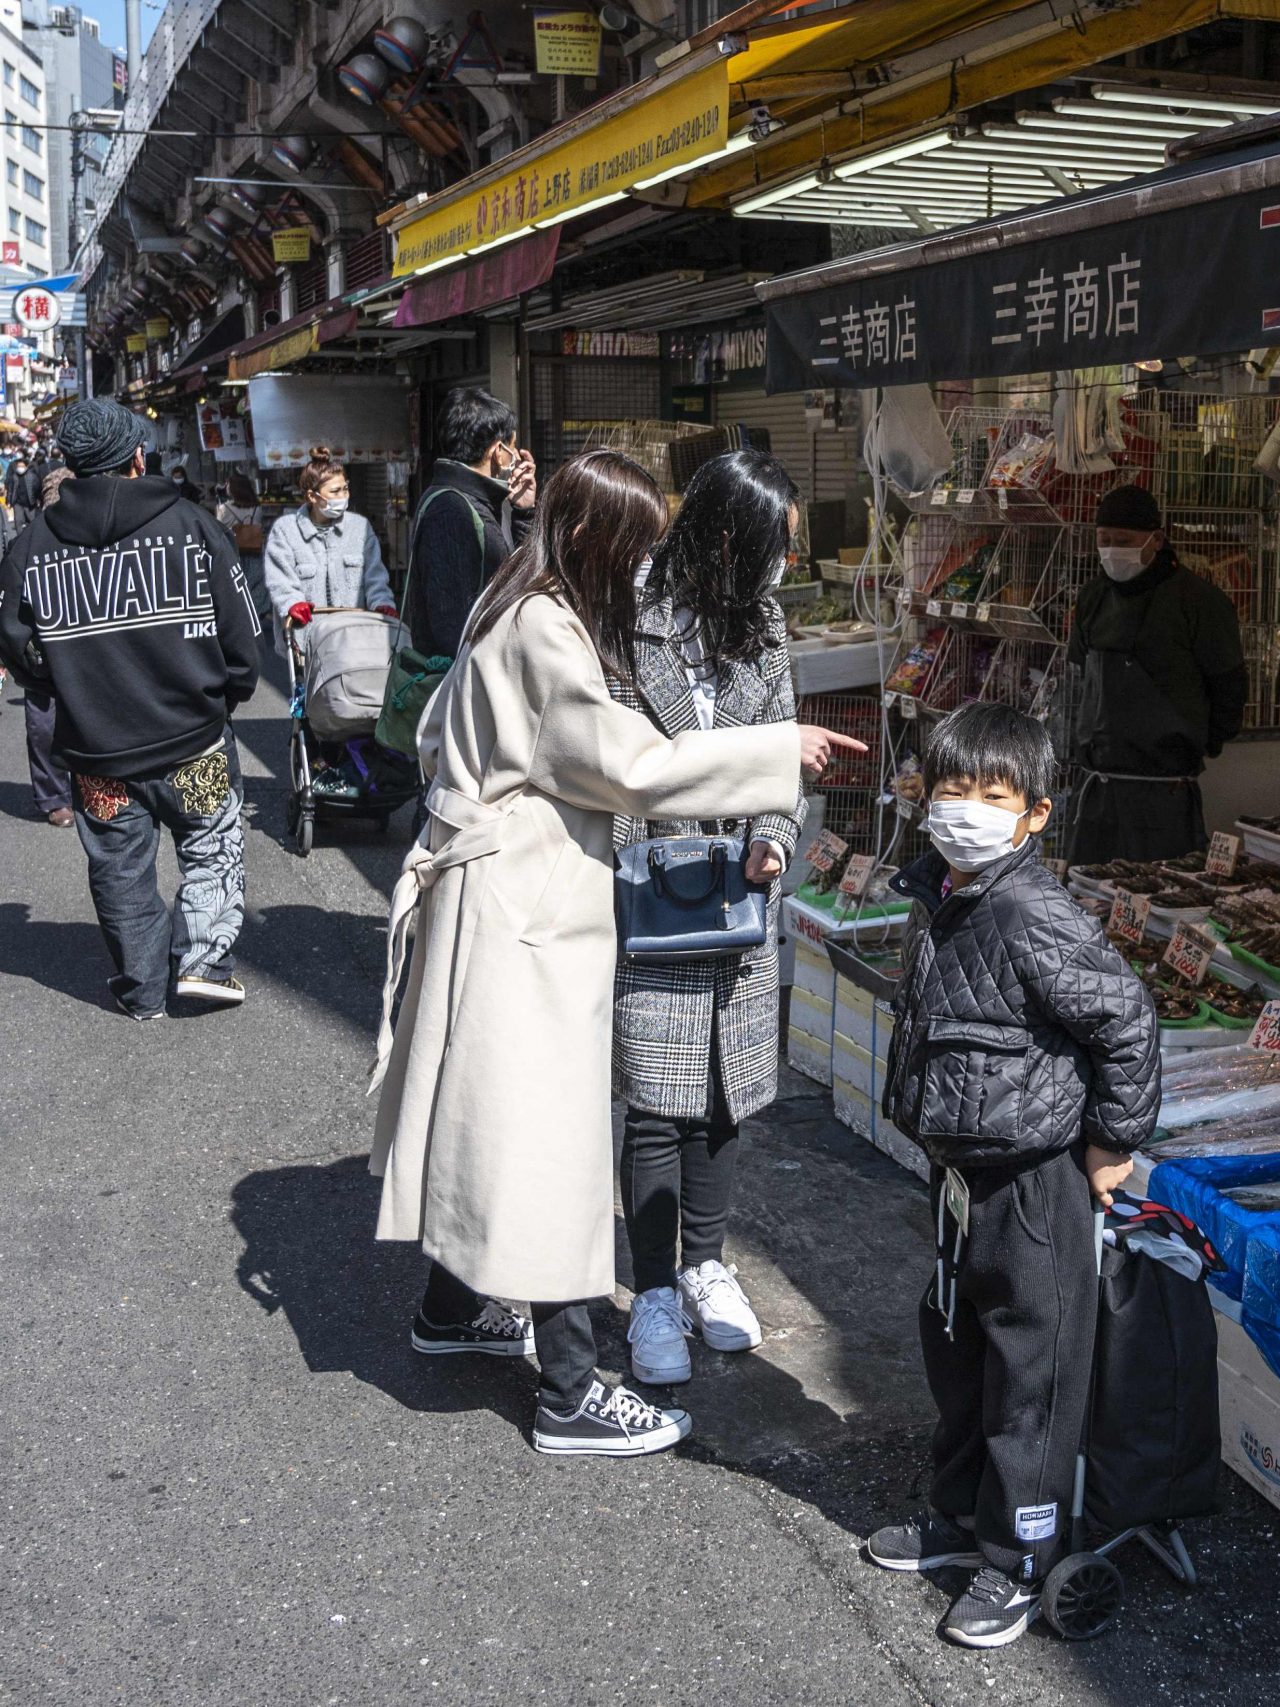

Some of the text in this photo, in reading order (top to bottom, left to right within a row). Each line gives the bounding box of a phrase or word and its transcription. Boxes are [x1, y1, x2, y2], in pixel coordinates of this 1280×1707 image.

[23, 295, 50, 321] 横
[811, 294, 918, 369] 三幸商店
[991, 252, 1142, 347] 三幸商店
